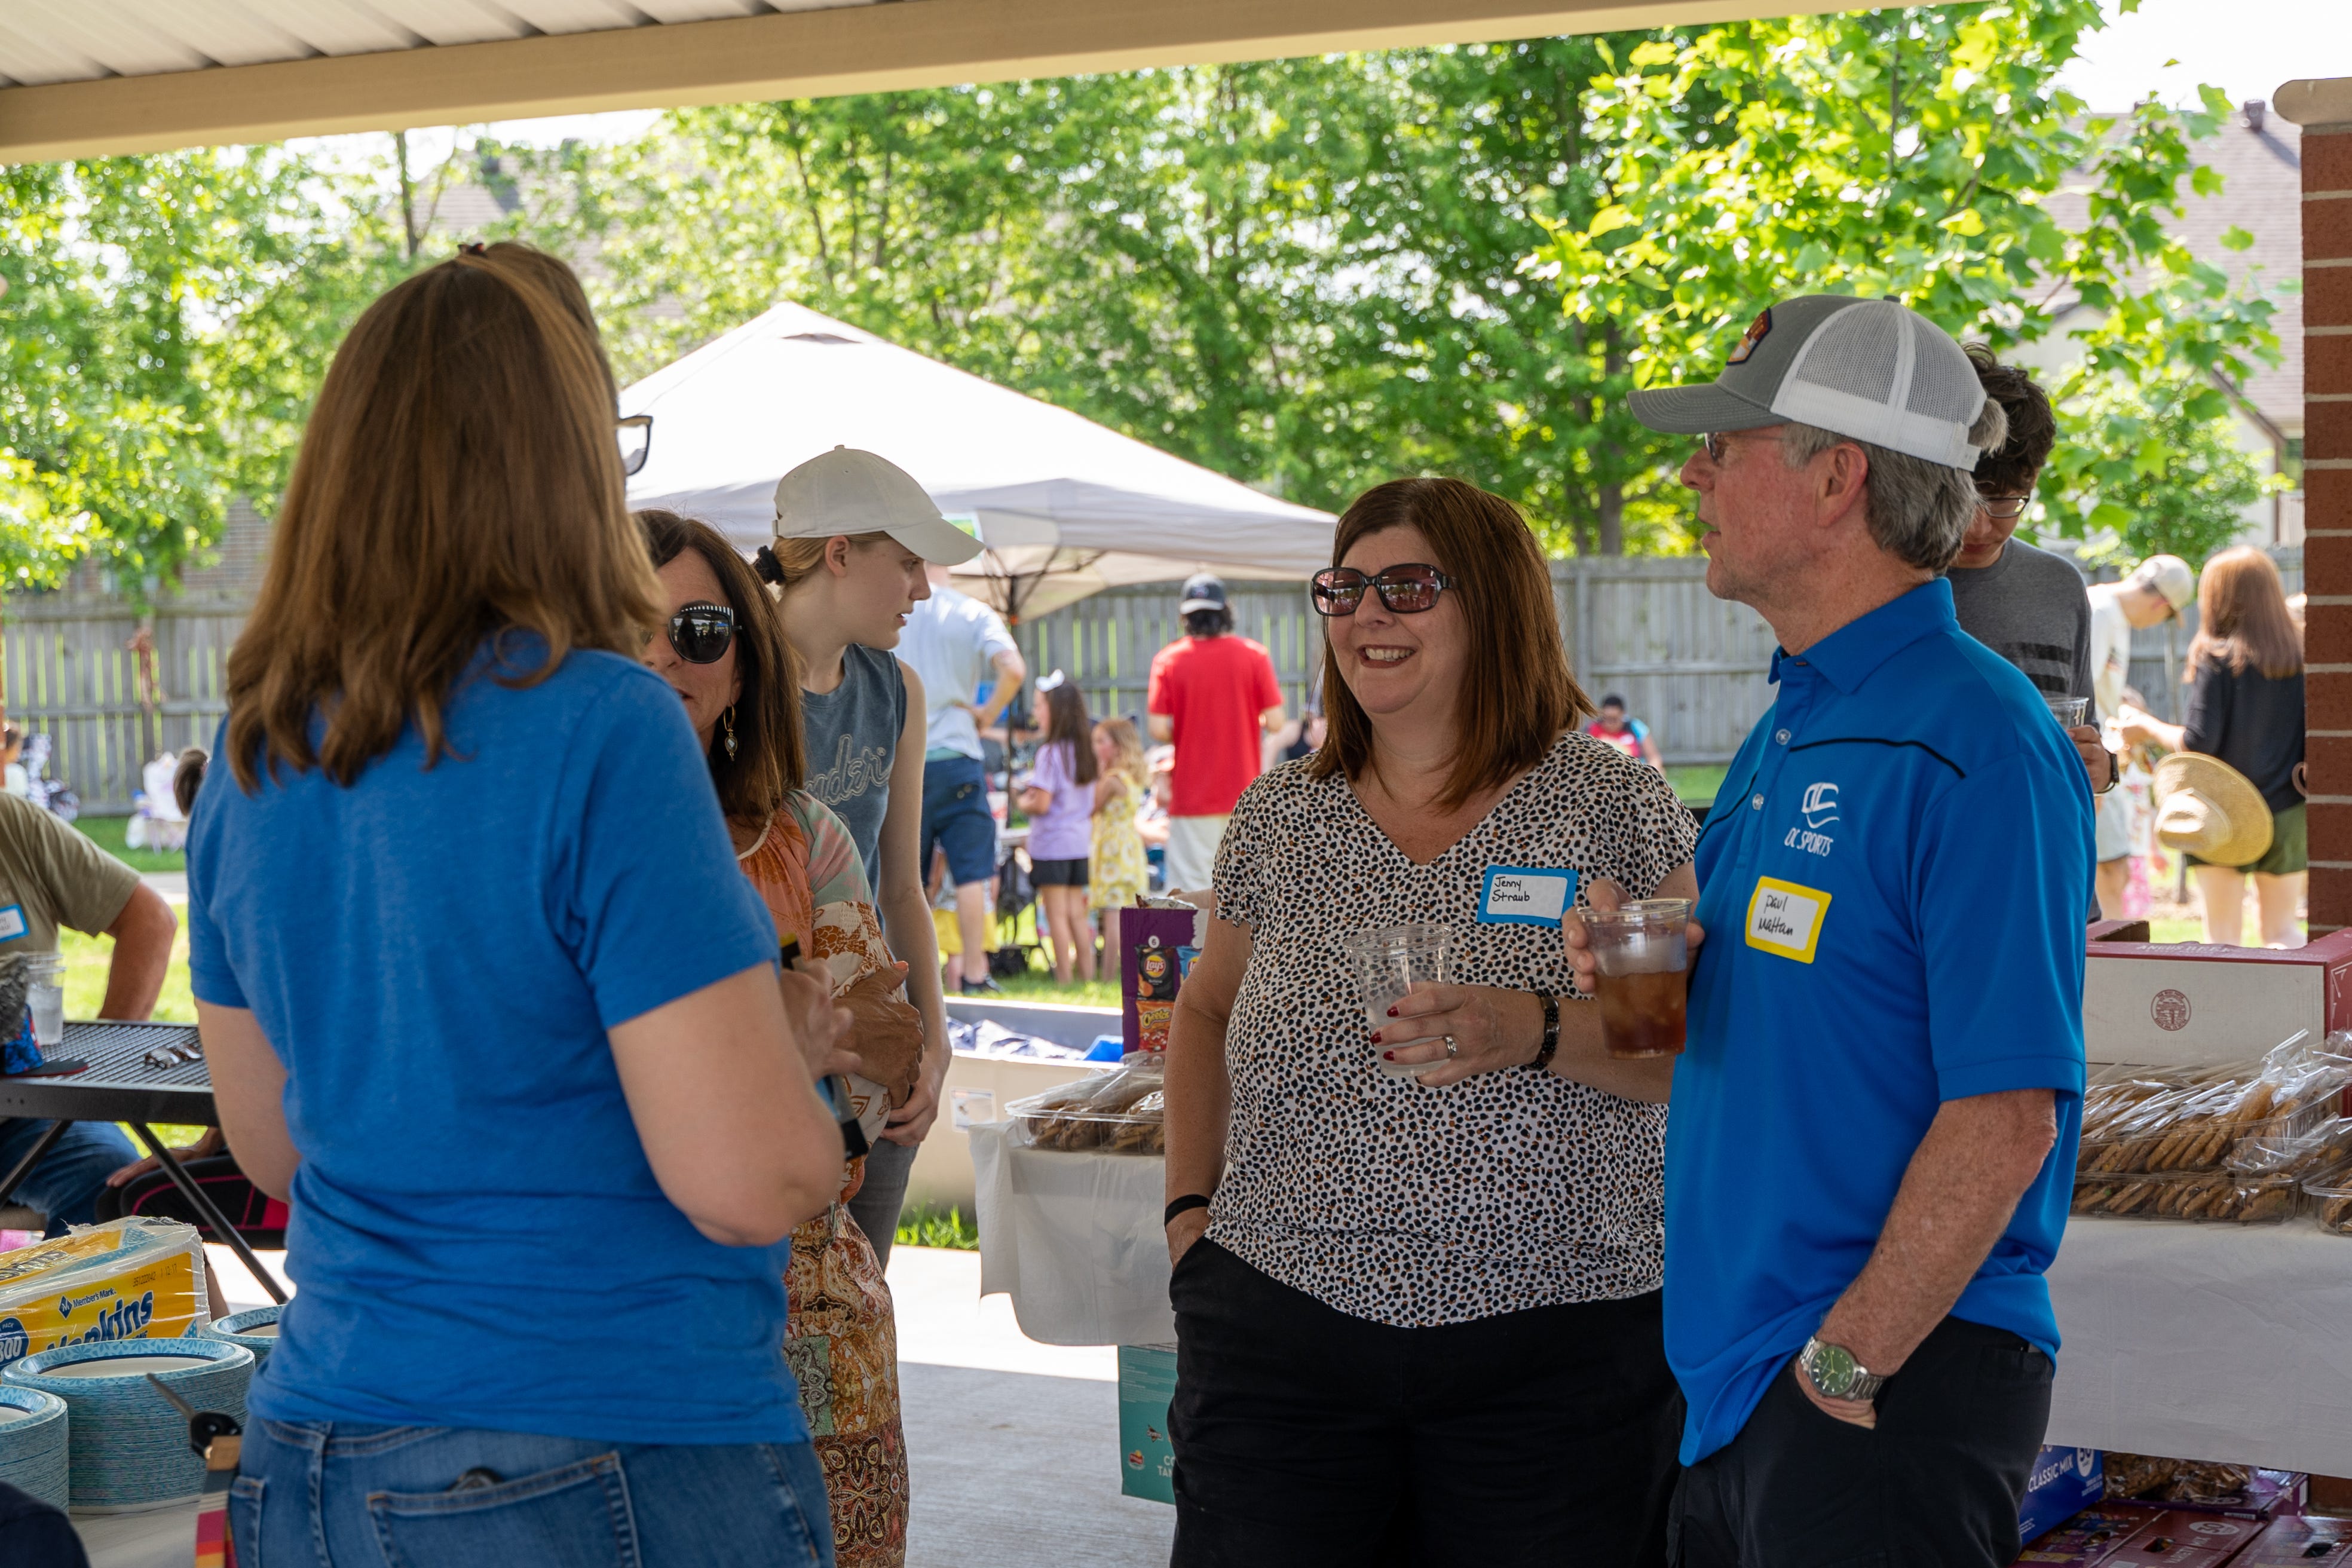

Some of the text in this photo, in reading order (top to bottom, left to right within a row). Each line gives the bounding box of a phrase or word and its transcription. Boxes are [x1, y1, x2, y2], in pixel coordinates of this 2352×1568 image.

[1796, 831, 1834, 857] SPORTS
[1494, 876, 1521, 892] Jenny
[1492, 889, 1530, 902] Straub
[1142, 1009, 1170, 1028] Cheetos
[73, 1288, 114, 1308] Member's Mark
[2028, 1462, 2059, 1493] CLASSIC
[2060, 1453, 2074, 1475] MIX
